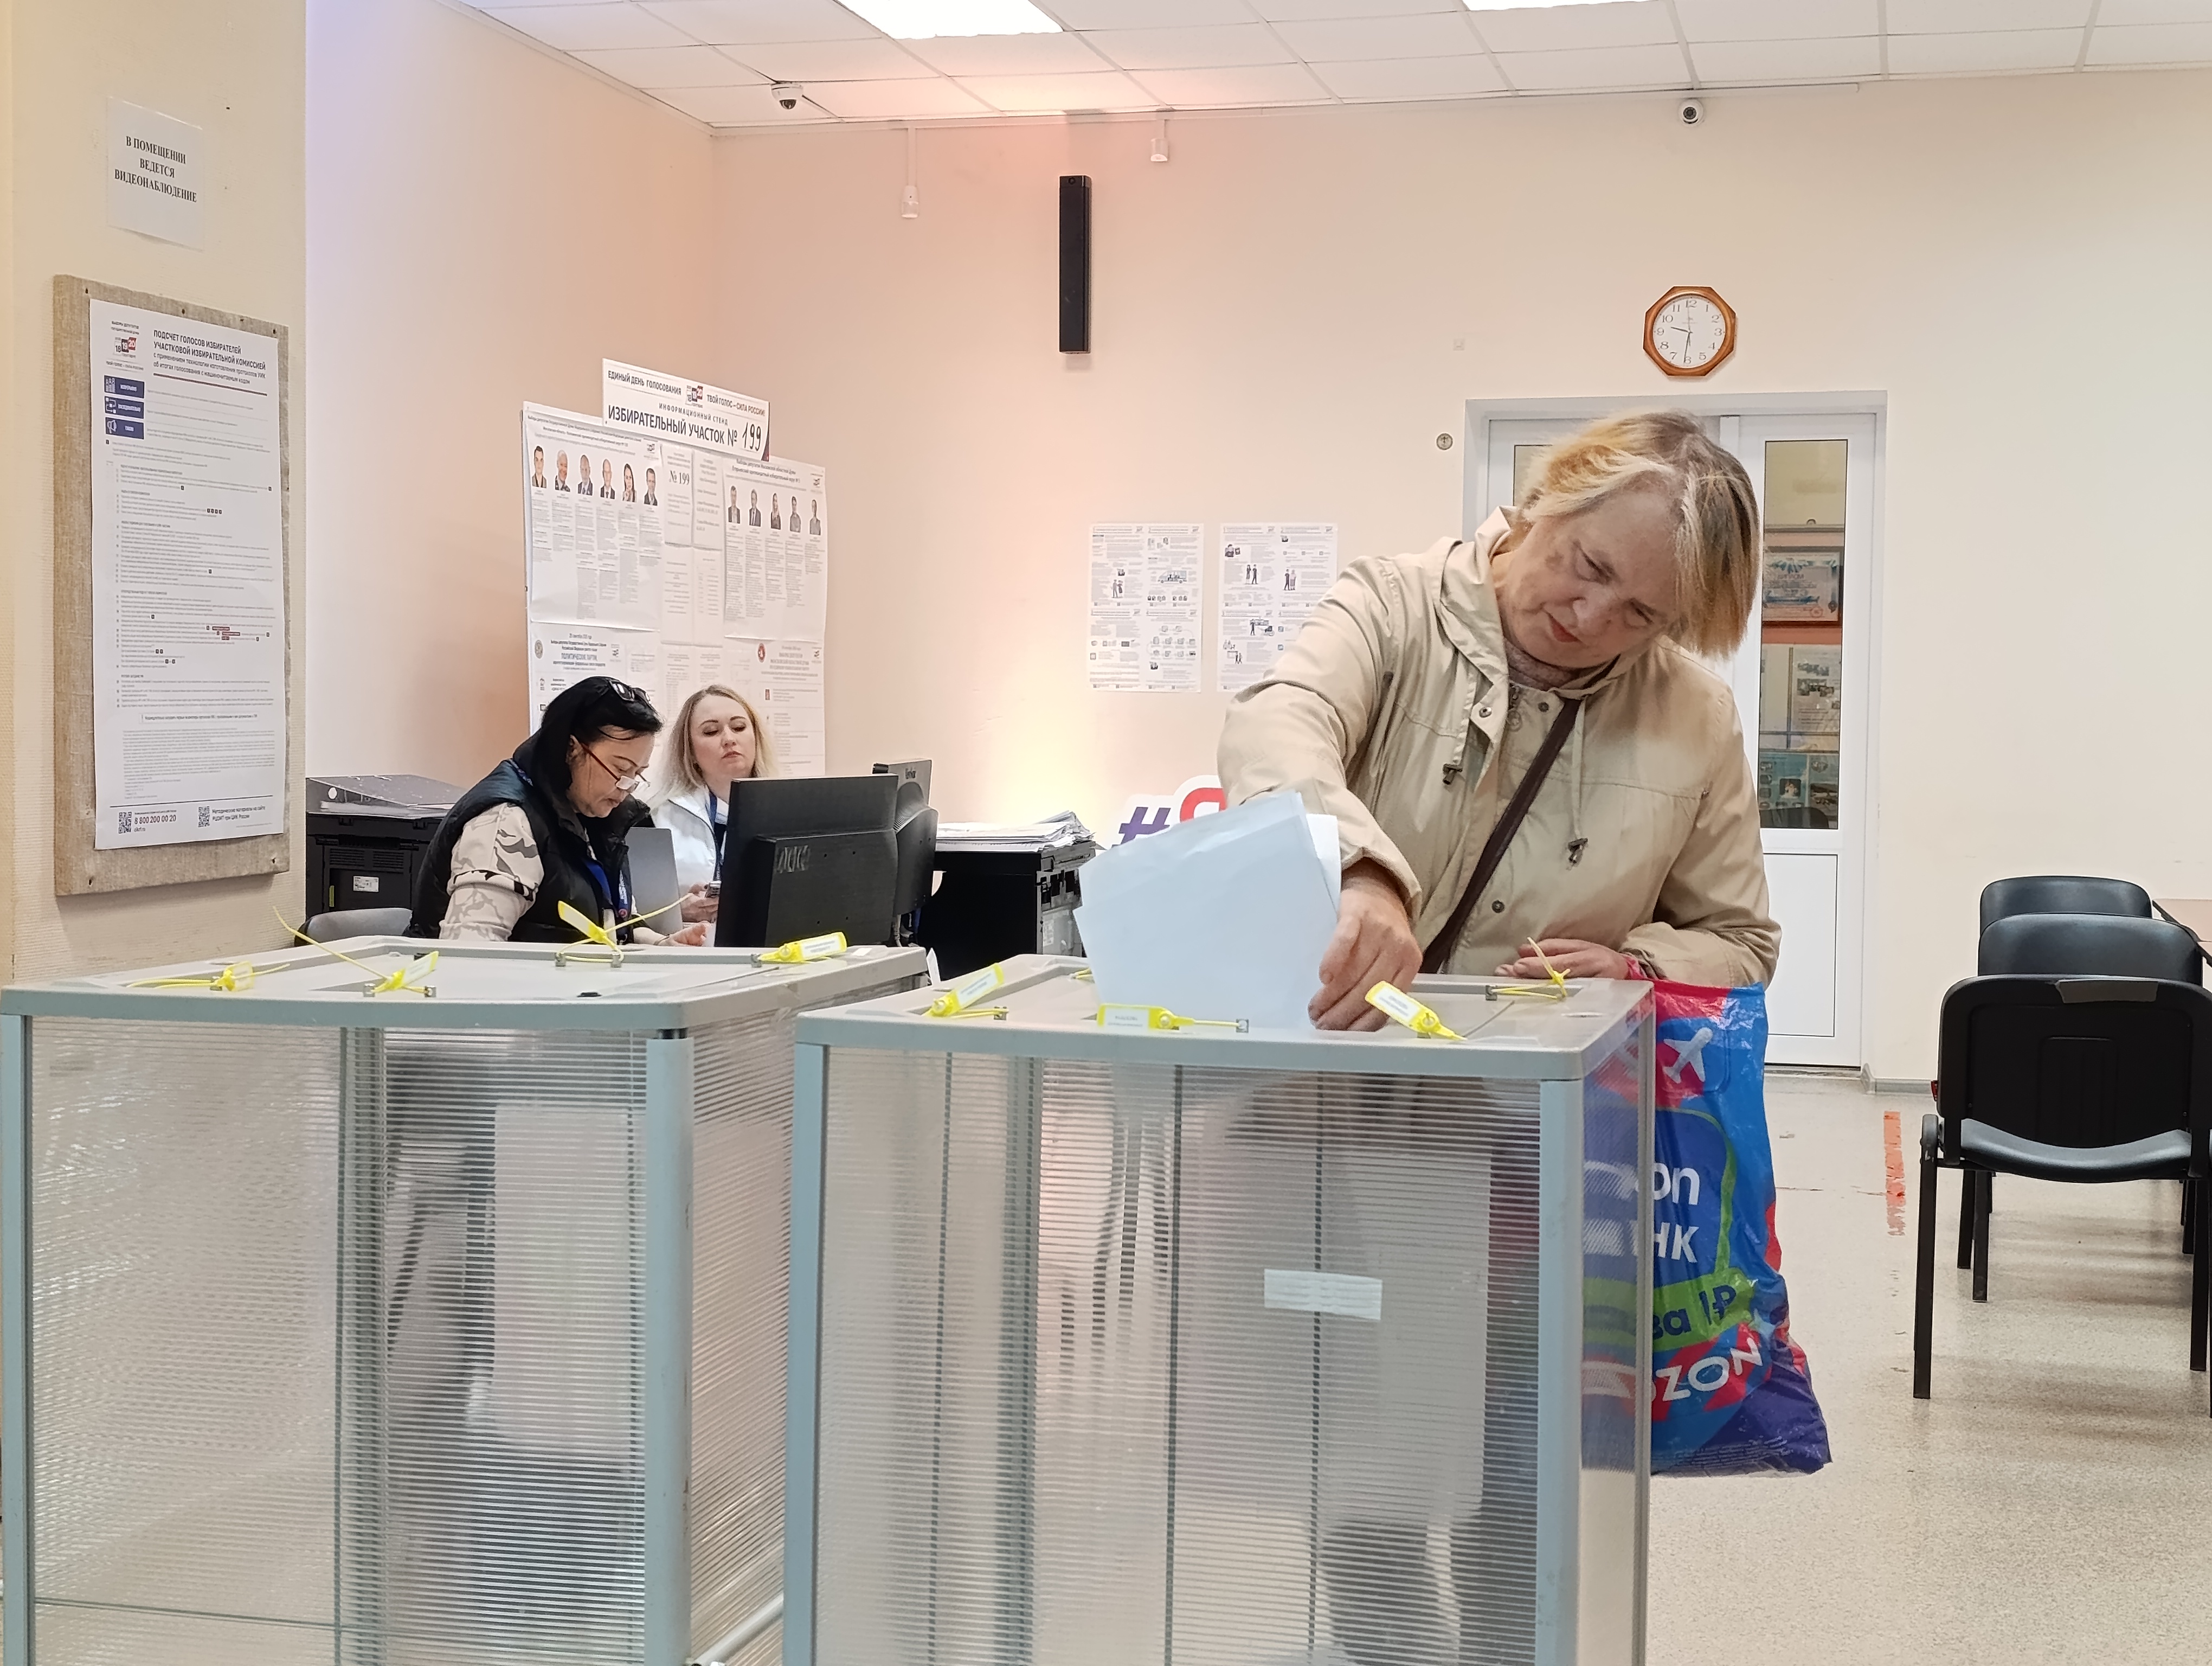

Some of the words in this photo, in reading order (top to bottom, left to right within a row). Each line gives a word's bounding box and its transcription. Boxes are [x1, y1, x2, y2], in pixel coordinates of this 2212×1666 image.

[126, 136, 131, 146] В
[133, 138, 186, 164] ПОМЕЩЕНИИ
[140, 158, 175, 178] ВЕДЕТСЯ
[114, 169, 197, 202] ВИДЕОНАБЛЮДЕНИЕ
[1662, 315, 1673, 323] 10
[1712, 315, 1719, 323] 2
[153, 330, 179, 342] ПОДСЧЕТ
[180, 335, 205, 347] ГОЛОСОВ
[206, 341, 241, 354] ИЗБИРАТЕЛЕЙ
[1657, 328, 1664, 336] 9
[1714, 328, 1722, 336] 3
[1660, 341, 1669, 349] 8
[153, 342, 190, 355] УЧАСТКОВОЙ
[191, 349, 235, 364] ИЗБИРАТЕЛЬНОЙ
[236, 358, 266, 370] КОМИССИЕЙ
[608, 370, 630, 383] ЕДИНЫЙ
[631, 376, 645, 386] ДЕНЬ
[646, 380, 681, 395] ГОЛОСОВАНИЯ
[706, 394, 718, 403] ТВОЙ
[719, 398, 732, 408] ГОЛОС
[736, 403, 748, 412] СИЛА
[659, 402, 711, 420] ИНФОРМАЦИОННЫЙ
[713, 416, 728, 426] СТЕНД
[608, 405, 686, 435] ИЗБИРАТЕЛЬНЫЙ
[689, 423, 725, 444] УЧАСТОК
[742, 422, 761, 451] 199
[679, 472, 690, 485] 199
[139, 816, 149, 824] 800
[1652, 1337, 1763, 1402] ZON
